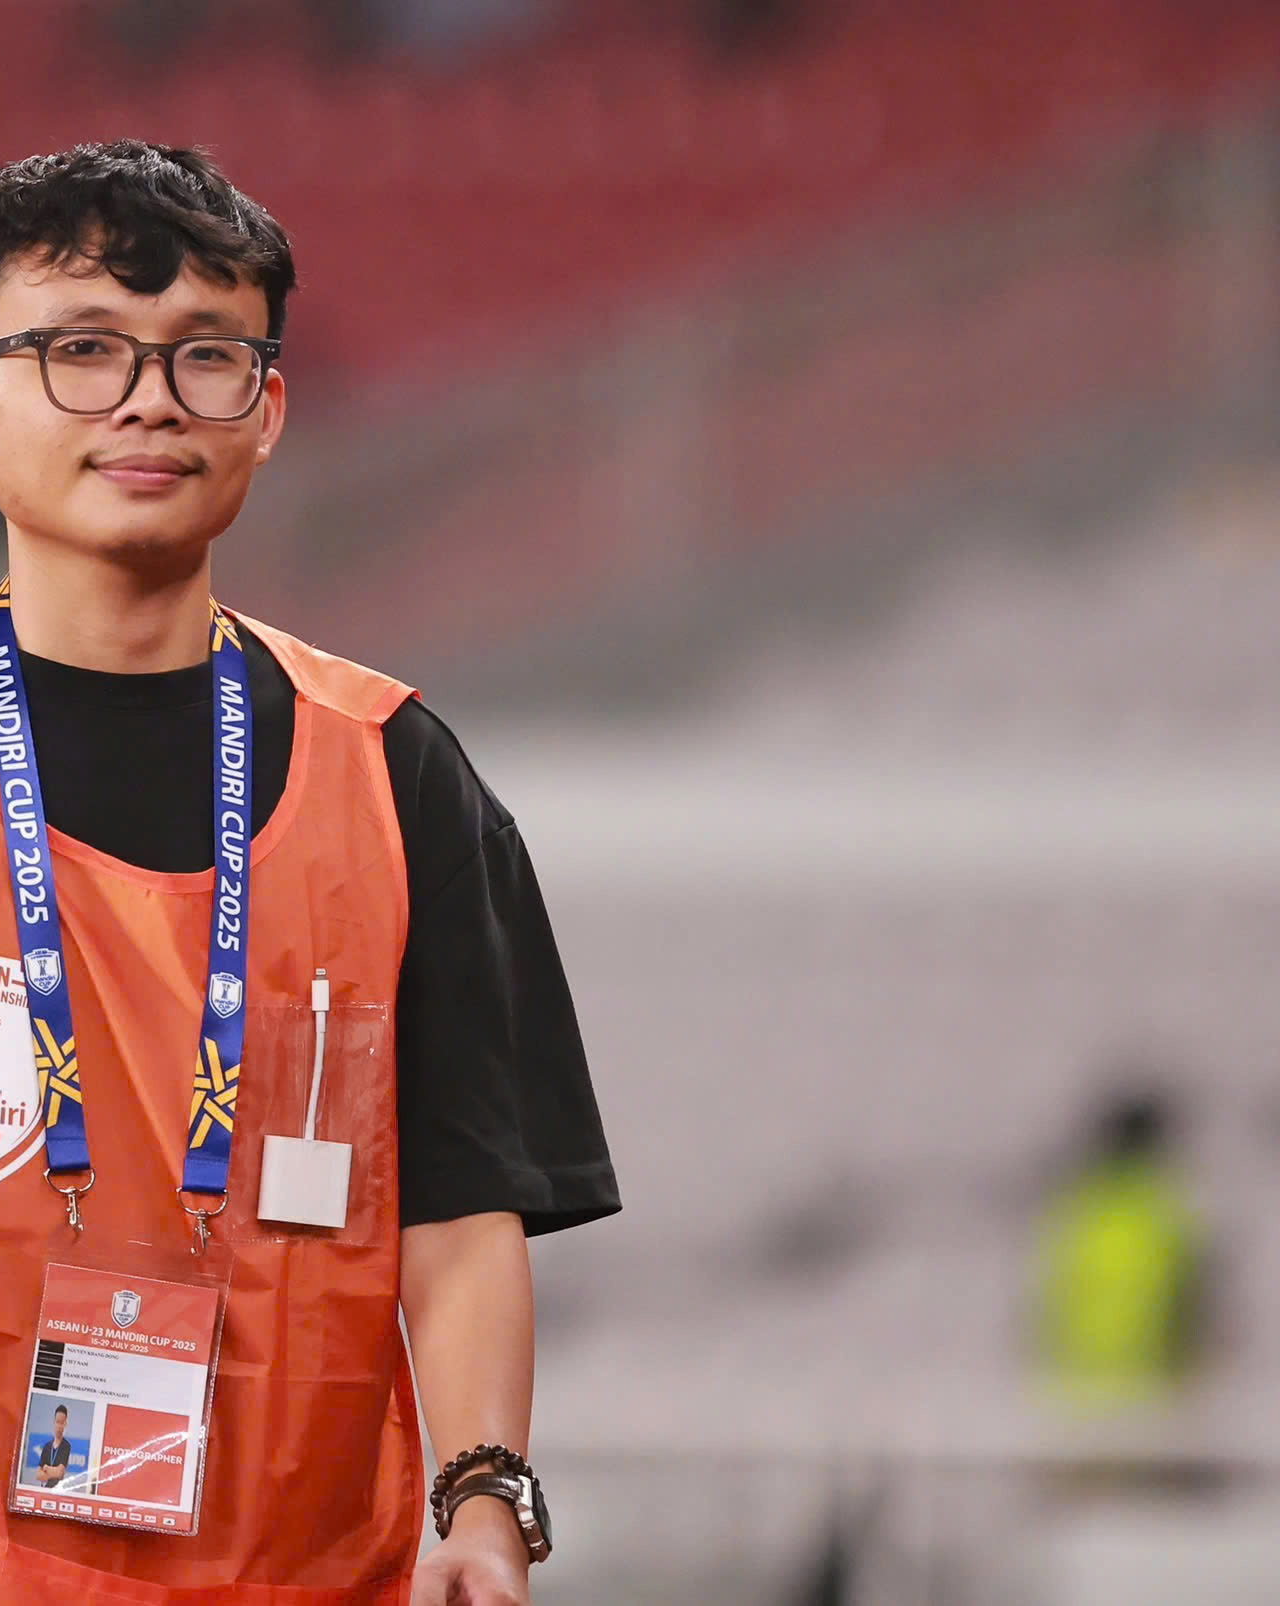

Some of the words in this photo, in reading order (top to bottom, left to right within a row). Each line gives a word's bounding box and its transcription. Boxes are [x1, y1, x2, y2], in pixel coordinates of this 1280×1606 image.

[219, 676, 245, 806] MANDIRI
[4, 778, 38, 839] CUP
[221, 810, 245, 873] CUP
[14, 847, 49, 924] 2025
[217, 875, 242, 952] 2025
[47, 1320, 80, 1333] ASEAN
[81, 1324, 103, 1337] U-23
[105, 1328, 149, 1344] MANDIRI
[150, 1336, 170, 1347] CUP
[172, 1340, 197, 1352] 2025
[111, 1341, 129, 1350] JULY
[130, 1344, 149, 1353] 2025
[103, 1446, 183, 1464] PHOTOGRAPHER
